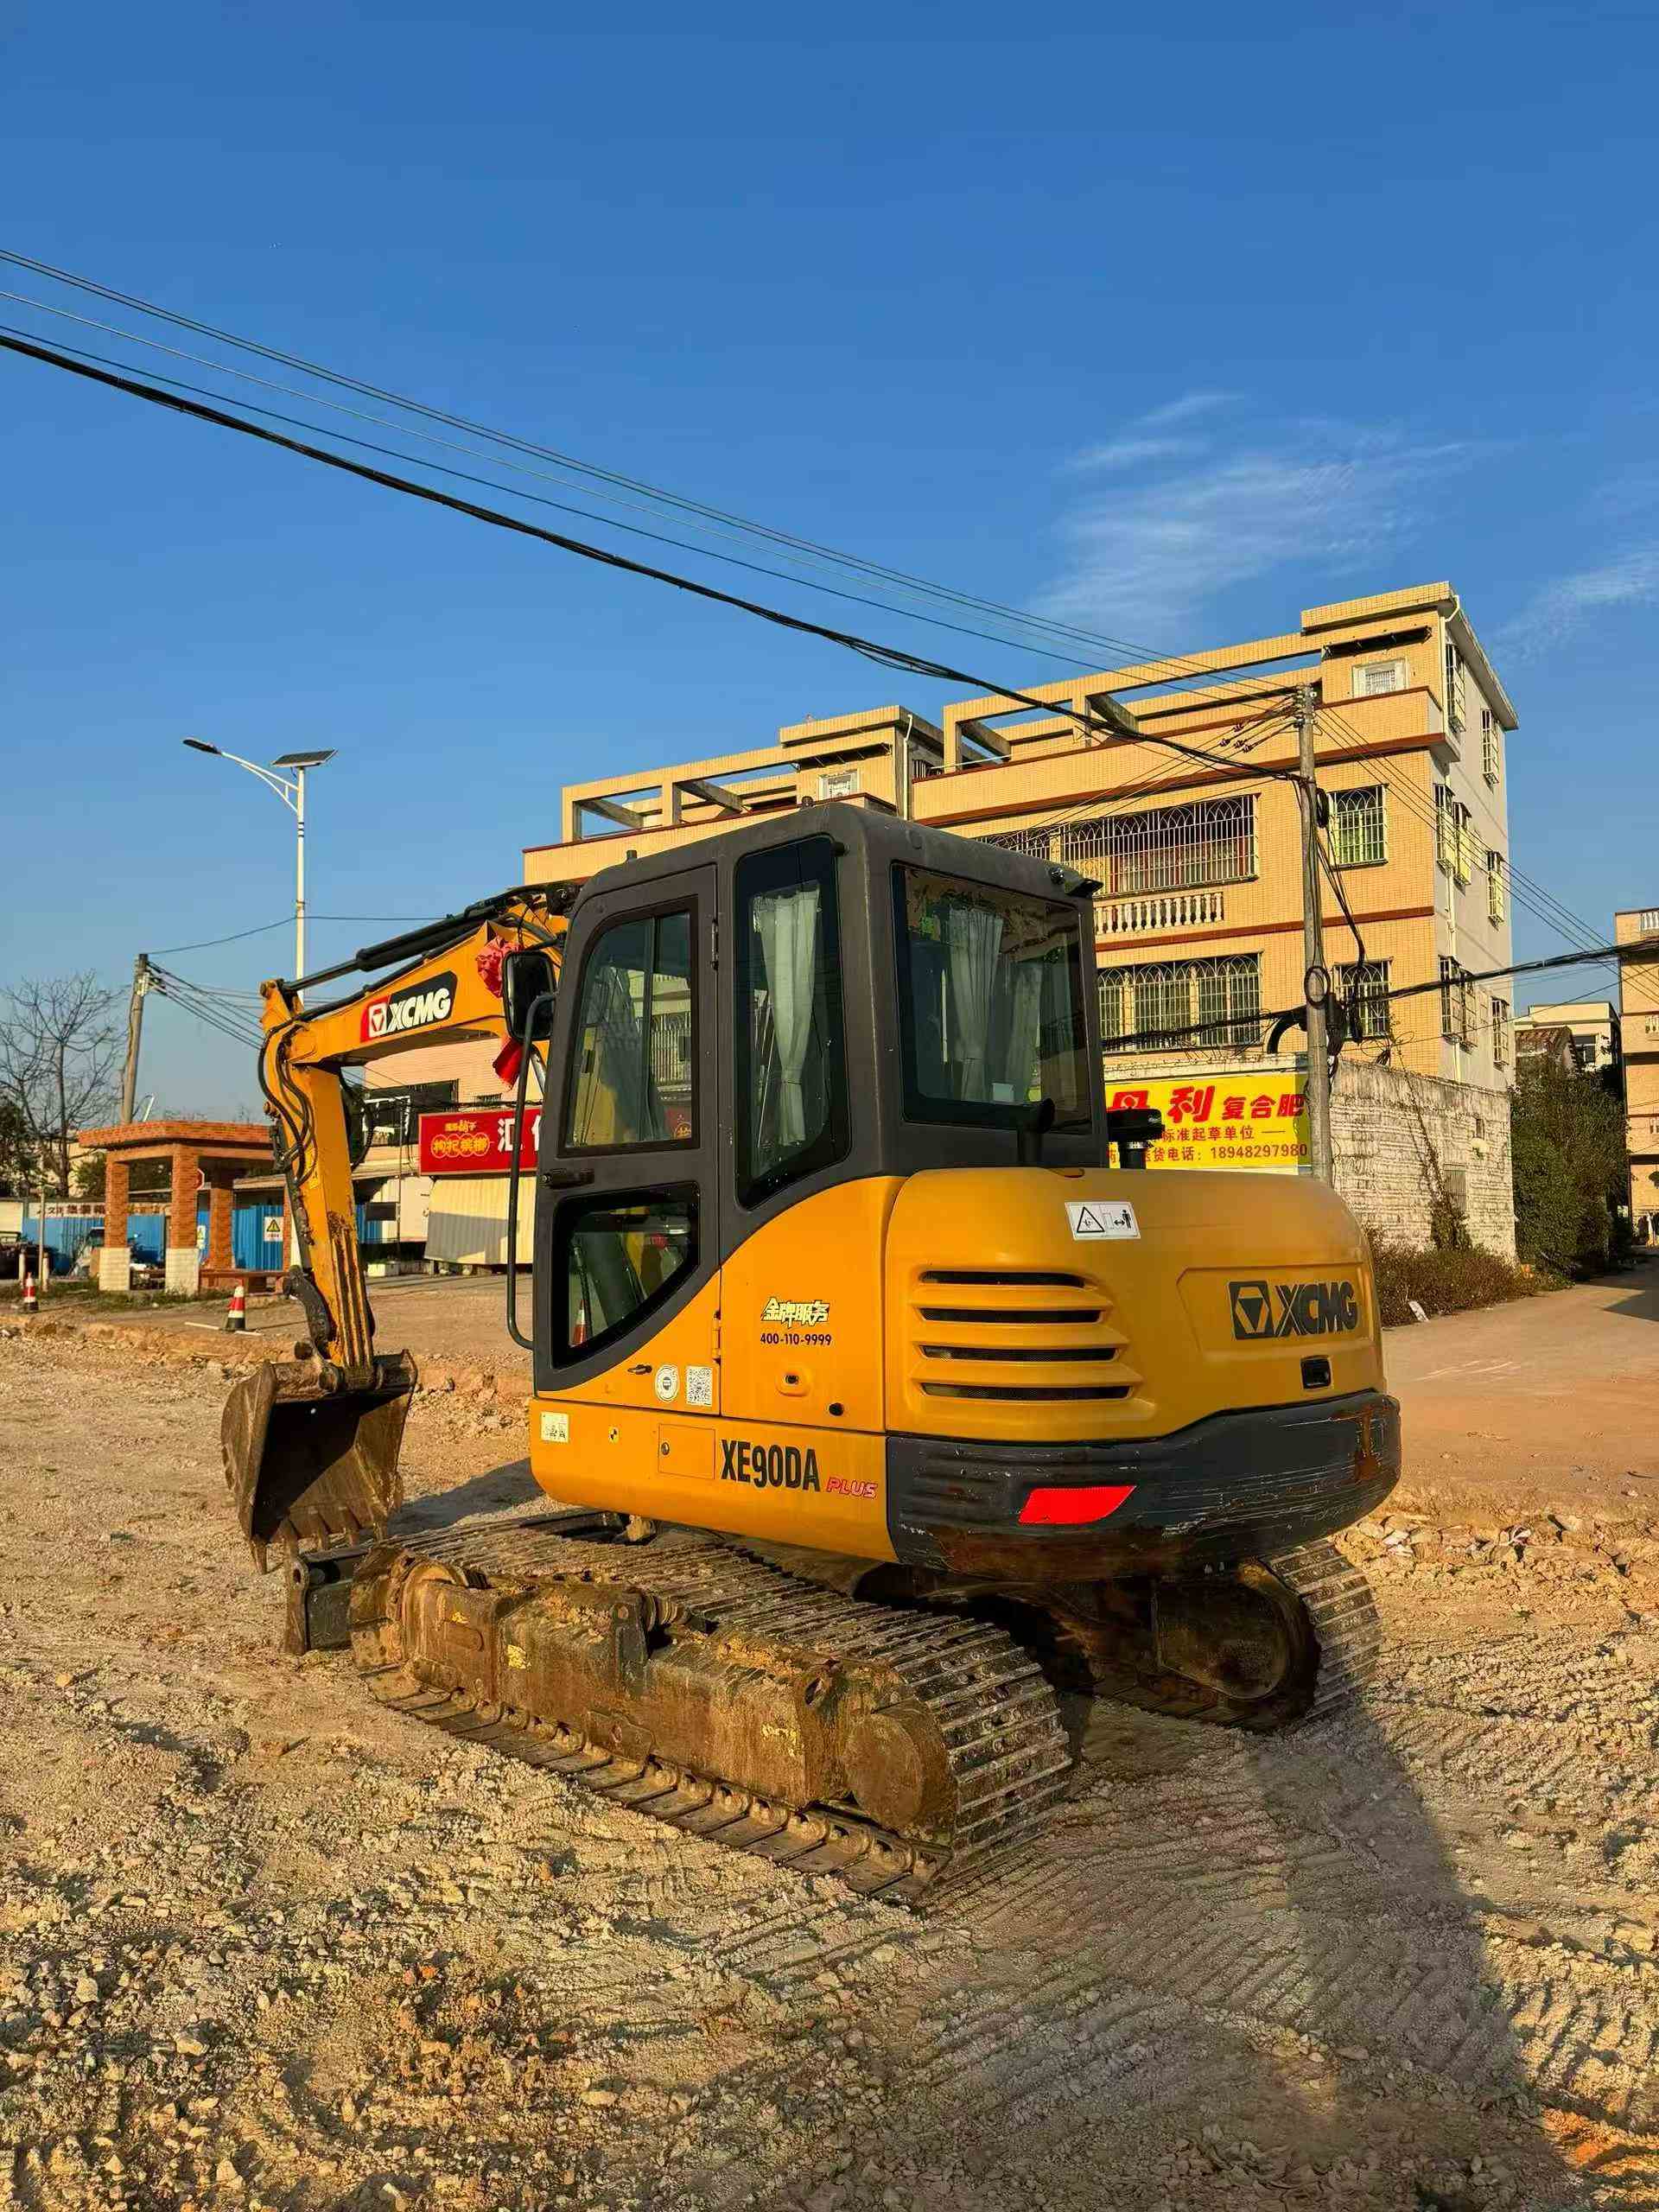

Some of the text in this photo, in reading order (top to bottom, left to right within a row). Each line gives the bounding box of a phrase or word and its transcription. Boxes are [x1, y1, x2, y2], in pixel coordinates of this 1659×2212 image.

[387, 988, 450, 1033] XCMG
[1222, 1093, 1306, 1121] 复合肥
[1210, 1143, 1307, 1160] 18948297980
[760, 1296, 830, 1329] 金牌服务
[1274, 1281, 1358, 1338] XCMG
[760, 1332, 832, 1345] 400-110-9999
[721, 1439, 879, 1499] XE90DA PLUS
